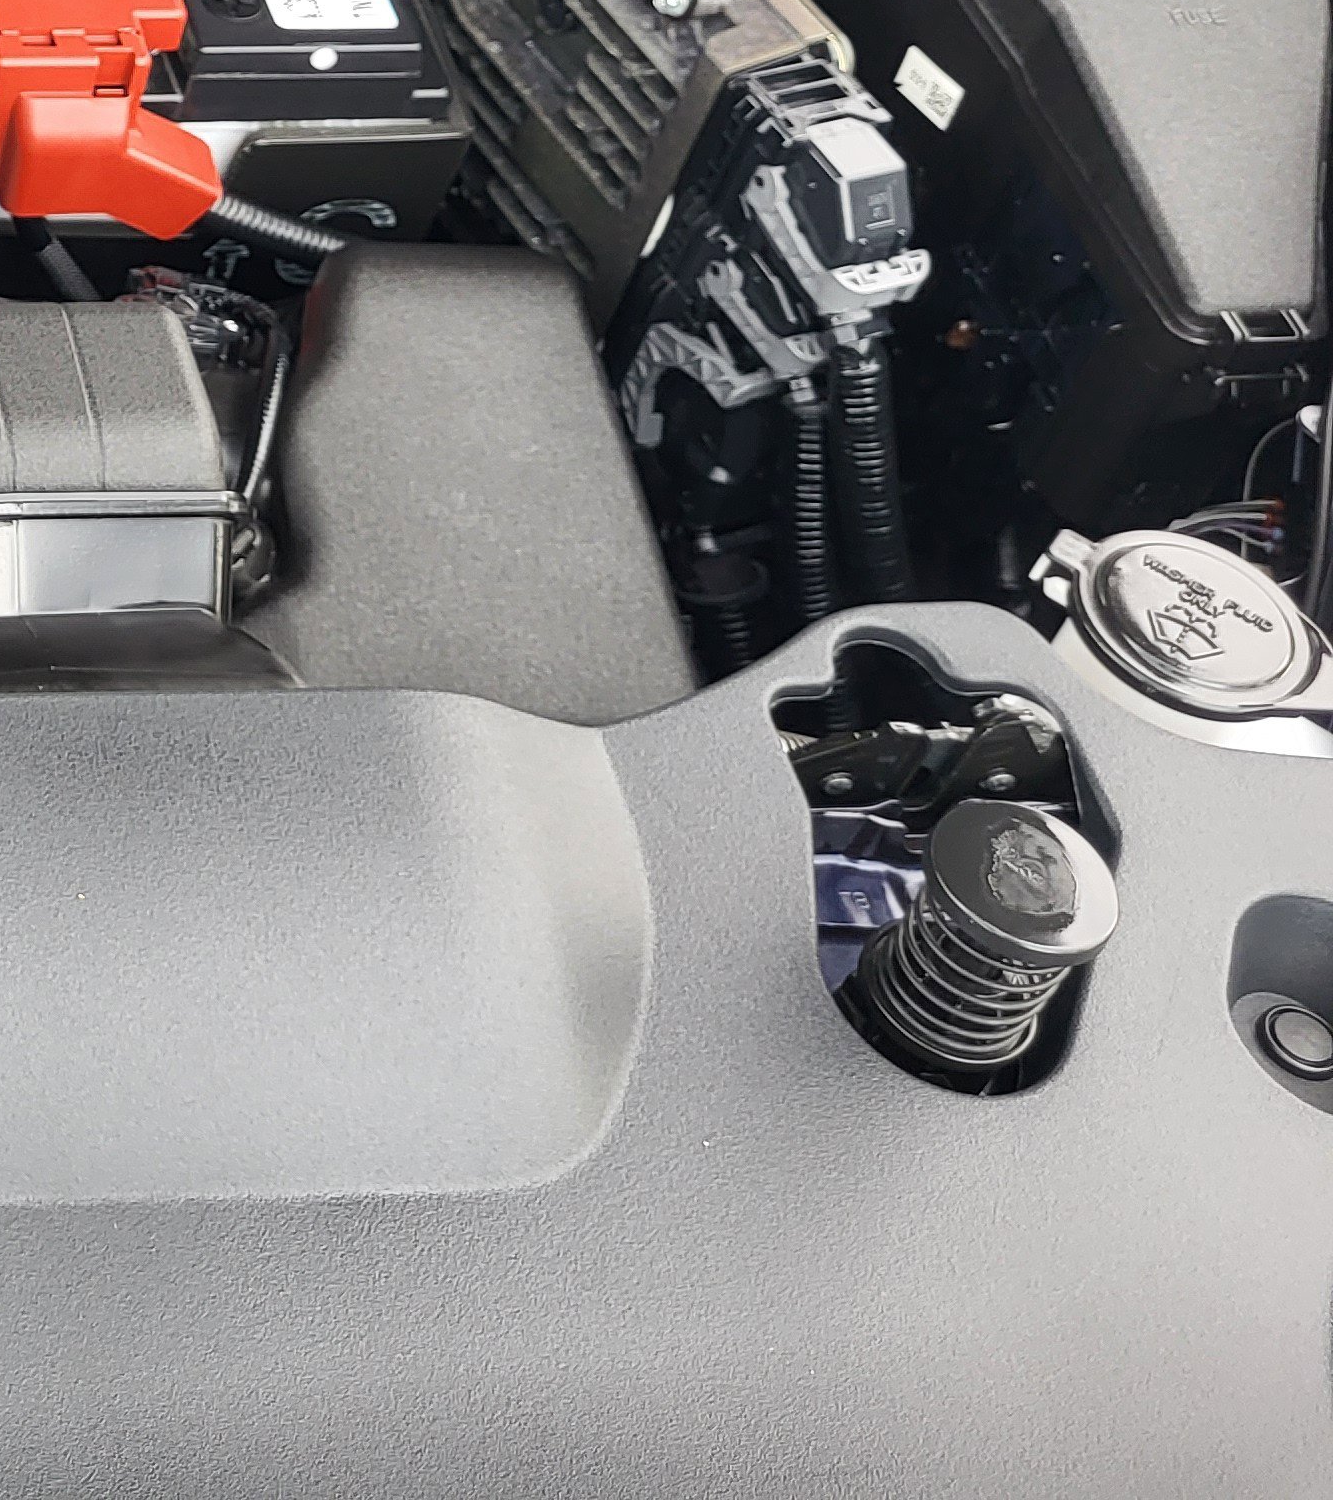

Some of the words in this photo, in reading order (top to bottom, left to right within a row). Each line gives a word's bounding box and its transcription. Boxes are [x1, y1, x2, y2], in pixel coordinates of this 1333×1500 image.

[1165, 6, 1227, 27] FUSE
[1142, 553, 1215, 601] WASHER
[1222, 598, 1274, 633] FLUID
[1178, 589, 1226, 619] ONLY
